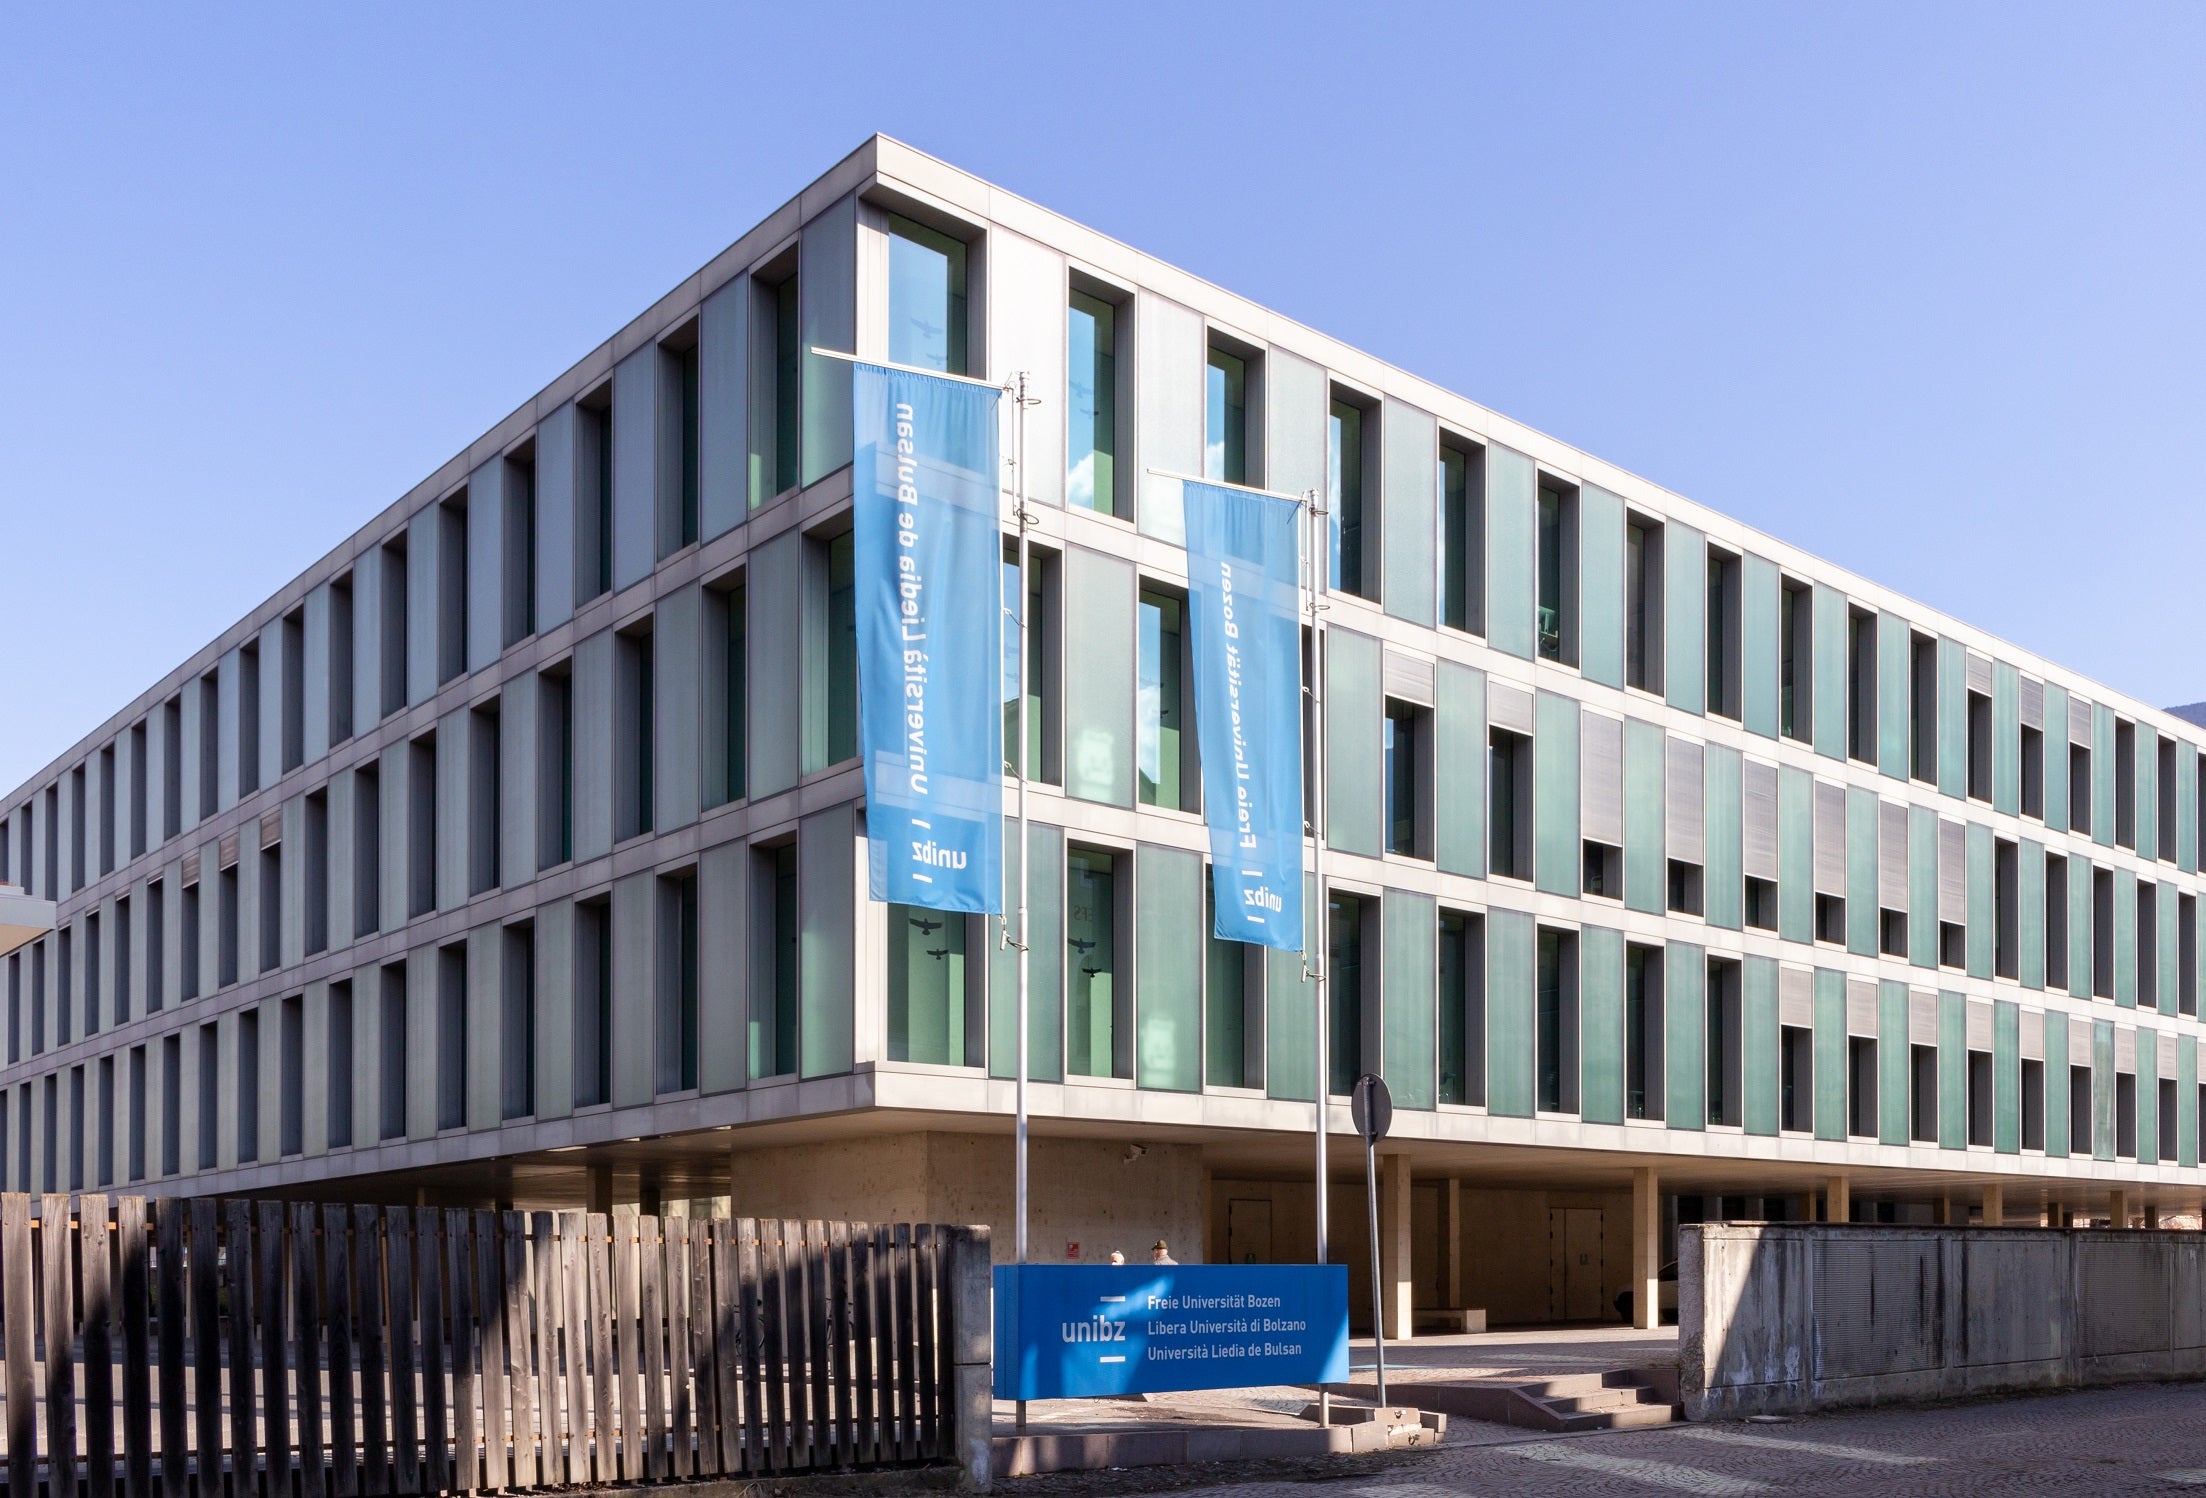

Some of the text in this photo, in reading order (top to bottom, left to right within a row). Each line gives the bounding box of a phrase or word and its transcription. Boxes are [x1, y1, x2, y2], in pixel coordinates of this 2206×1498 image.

[1148, 1294, 1281, 1310] Freie Universität Bozen
[1062, 1315, 1126, 1342] unibz
[1148, 1317, 1306, 1336] Libera Università di Bolzano
[1148, 1342, 1302, 1361] Università Liedia de Bulsan
